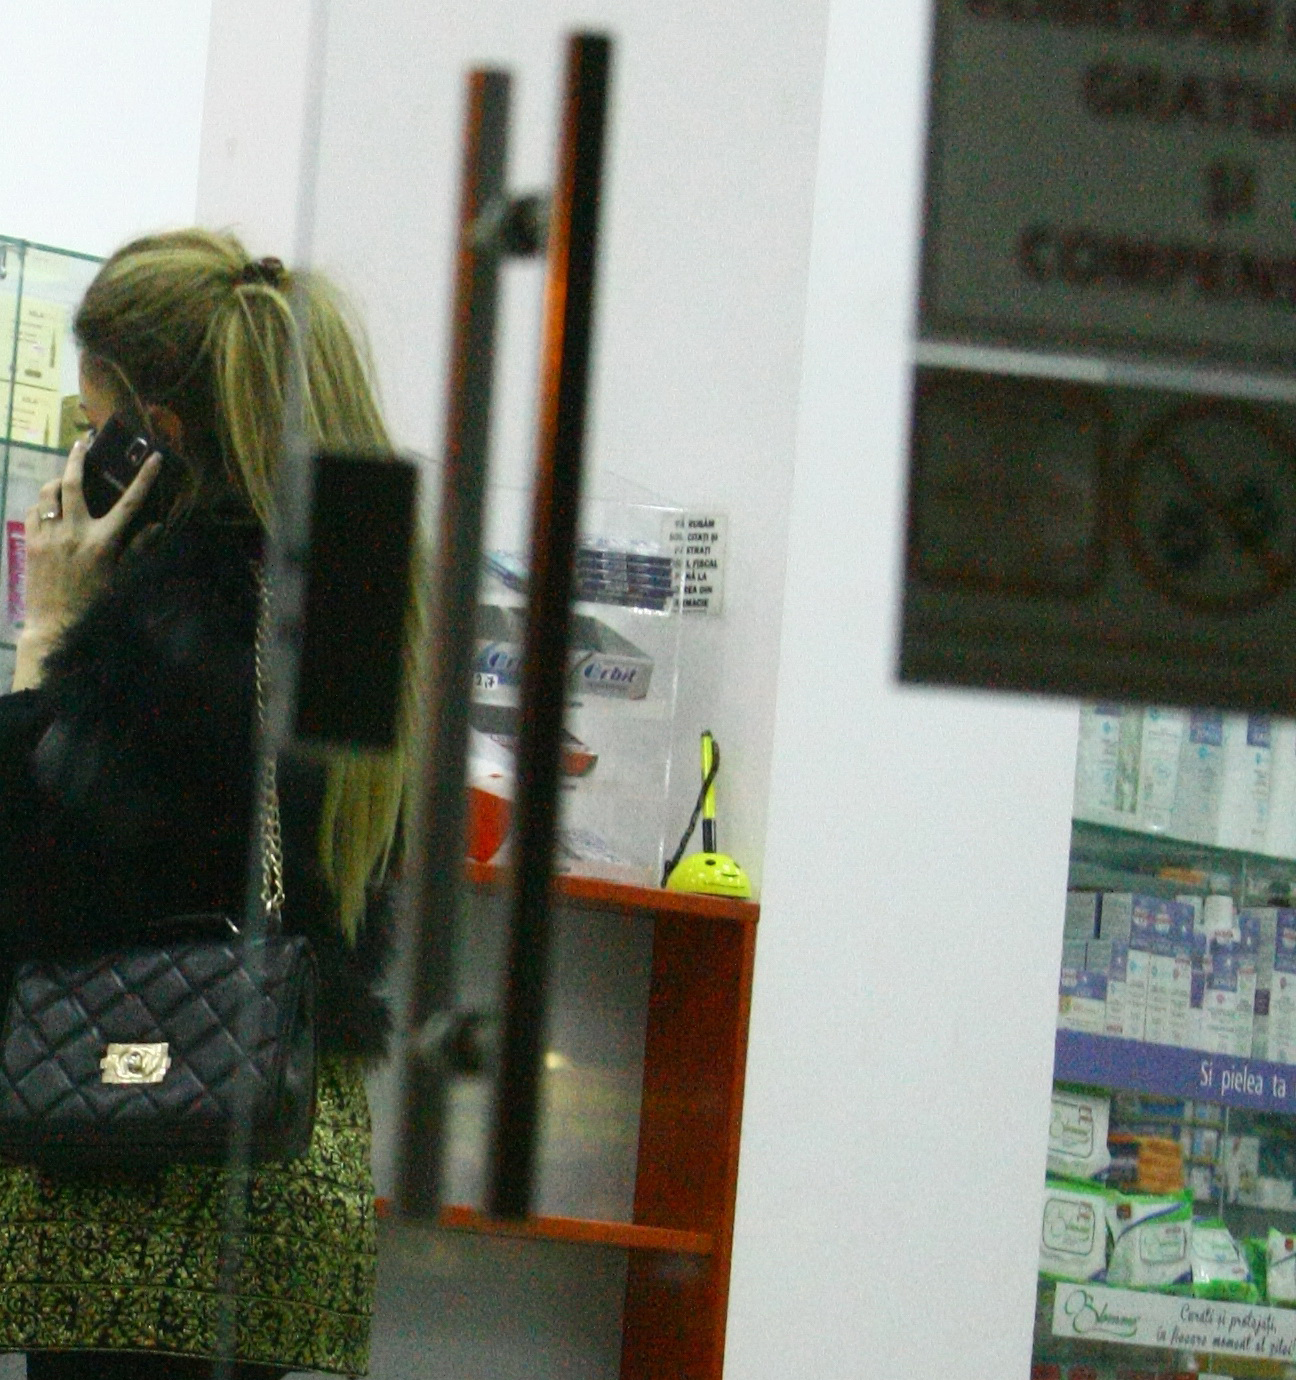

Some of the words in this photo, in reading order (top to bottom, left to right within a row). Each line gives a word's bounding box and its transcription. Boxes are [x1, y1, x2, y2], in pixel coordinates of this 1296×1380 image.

[584, 663, 637, 683] Orbit
[1221, 1065, 1263, 1096] pielea
[1272, 1075, 1286, 1098] ta
